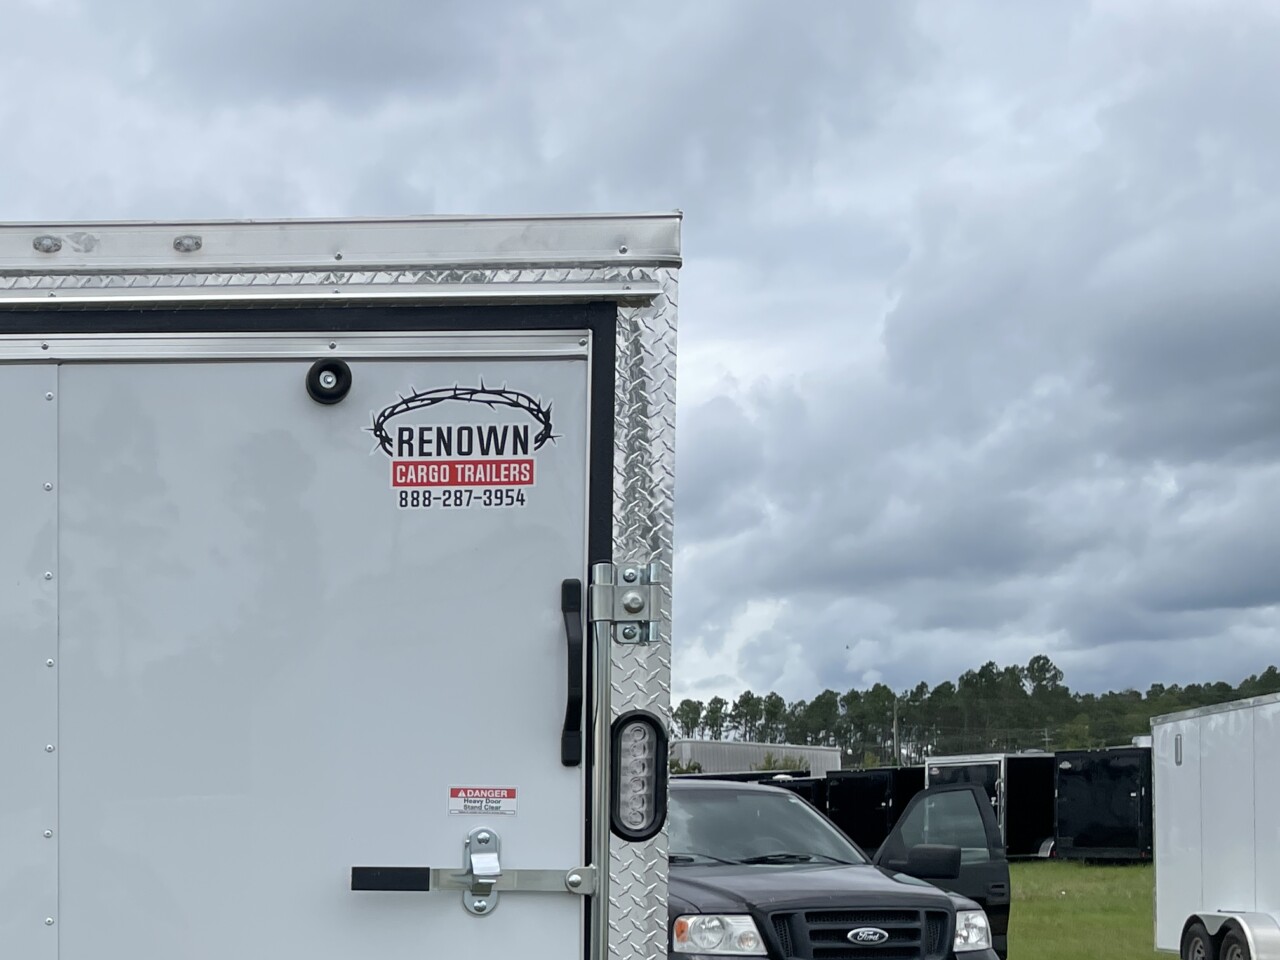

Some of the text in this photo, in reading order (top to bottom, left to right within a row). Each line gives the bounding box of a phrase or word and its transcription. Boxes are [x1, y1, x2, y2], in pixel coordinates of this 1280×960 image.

[397, 424, 529, 457] RENOWN
[396, 463, 530, 483] CARGO TRAILERS
[399, 489, 526, 508] 888-287-3954
[857, 931, 879, 940] Ford
